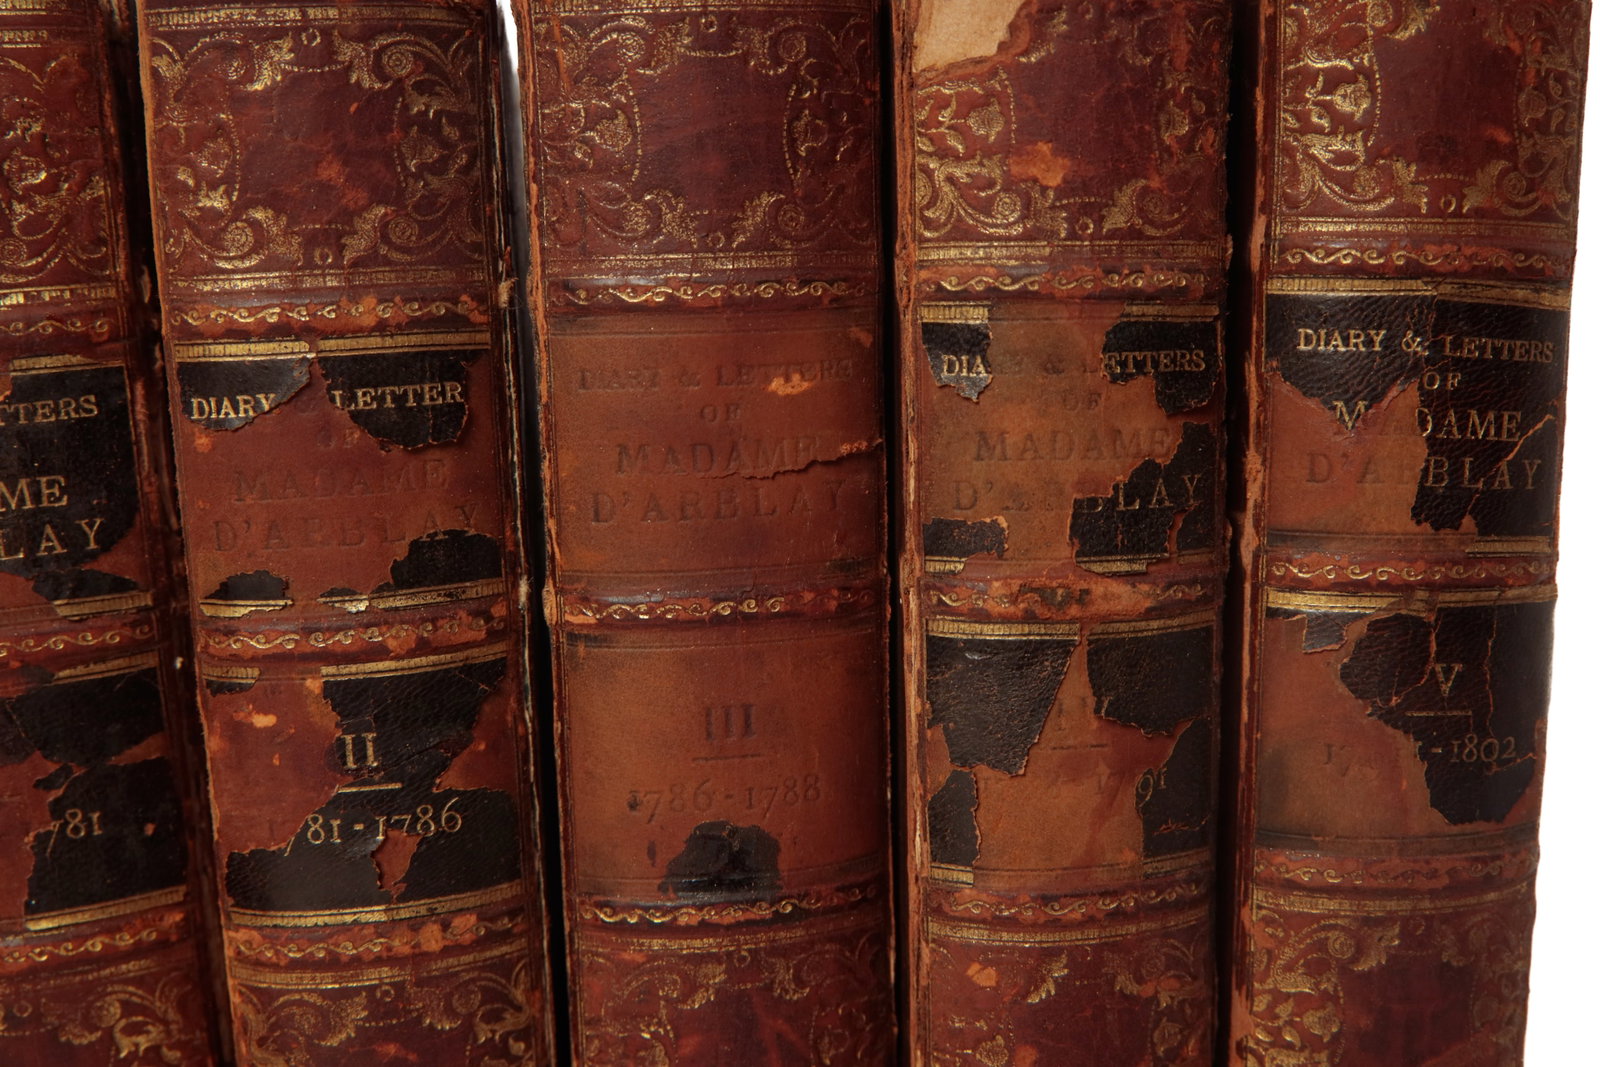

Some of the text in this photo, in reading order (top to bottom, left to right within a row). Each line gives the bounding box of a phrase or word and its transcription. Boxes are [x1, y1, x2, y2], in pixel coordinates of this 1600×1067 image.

[1297, 328, 1554, 364] DIARY & LETTERS
[1422, 371, 1462, 391] OF
[190, 381, 465, 421] DIARY LETTER
[1434, 662, 1463, 697] V
[704, 702, 758, 741] III
[340, 732, 381, 770] II
